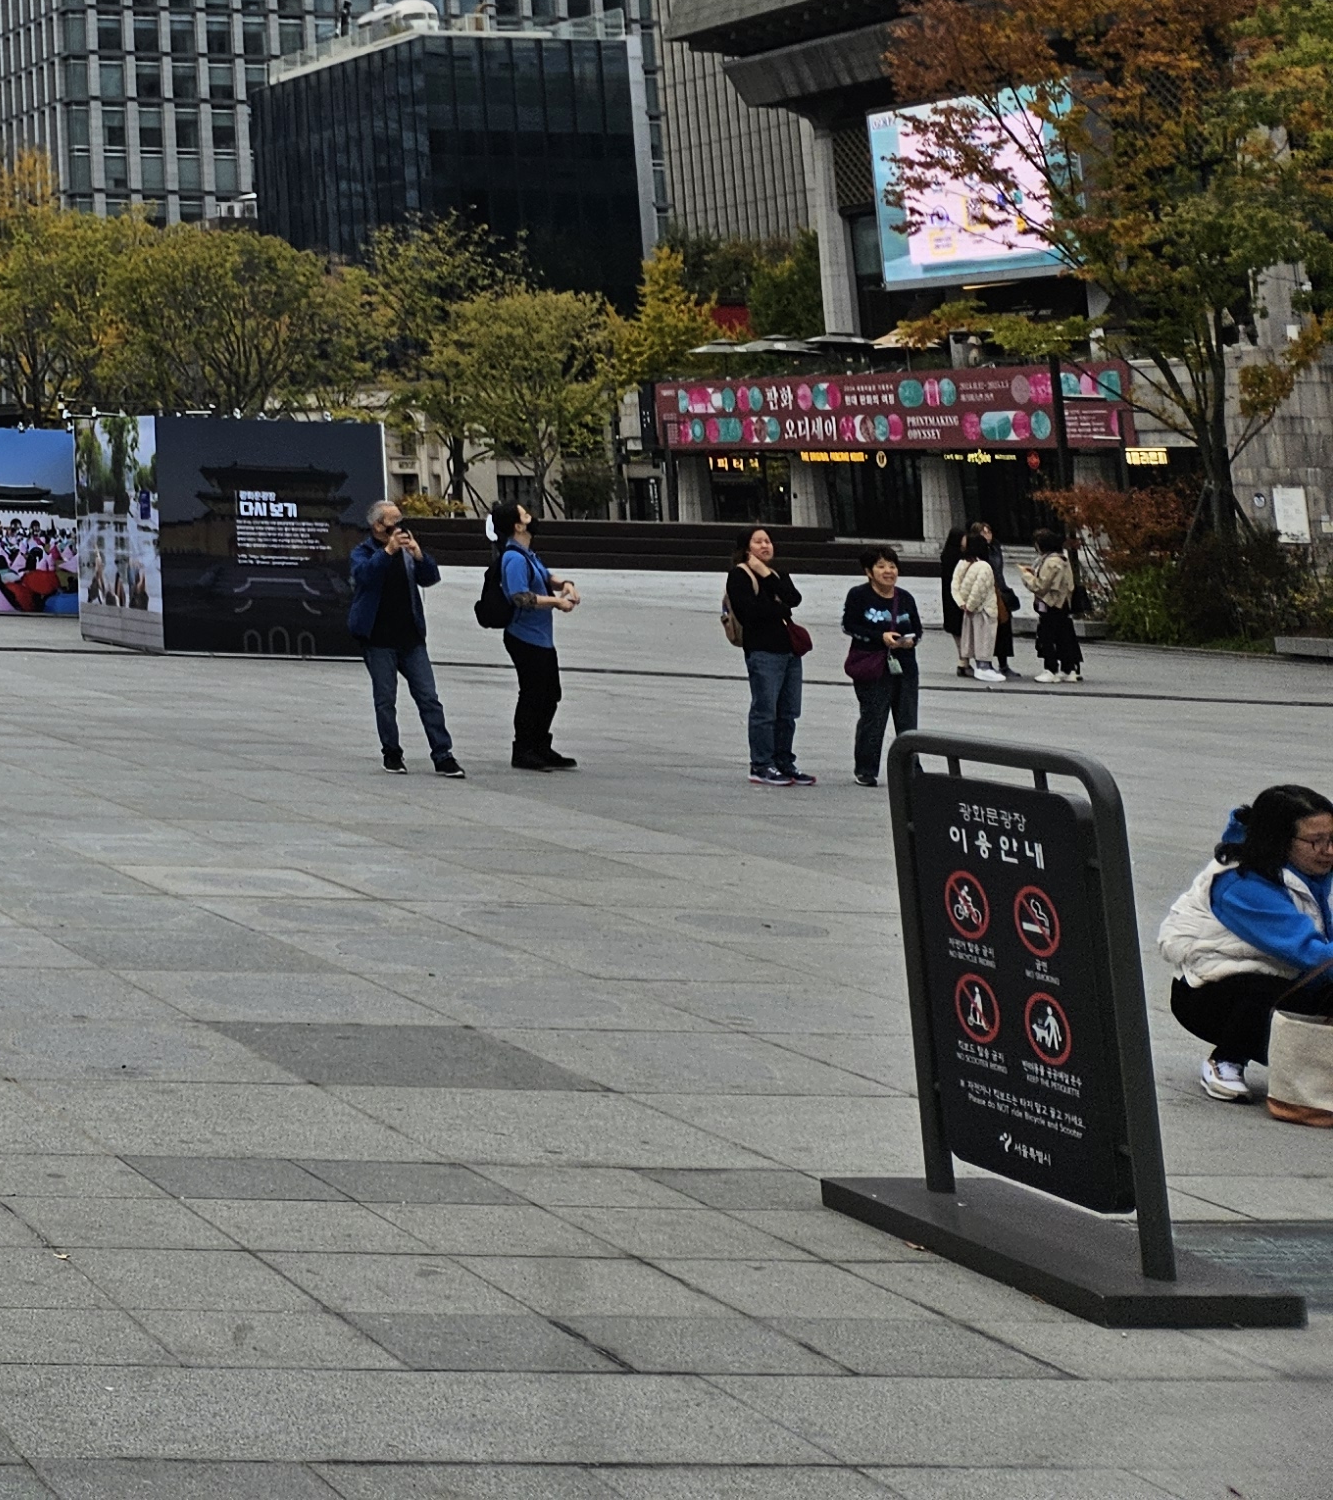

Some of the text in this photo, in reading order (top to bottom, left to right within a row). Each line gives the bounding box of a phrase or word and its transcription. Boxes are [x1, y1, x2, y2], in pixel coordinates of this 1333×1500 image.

[765, 385, 793, 411] 판화
[784, 415, 837, 442] 오디세이
[906, 415, 960, 427] PRINTMAKING
[907, 428, 941, 440] ODYSSEY
[239, 501, 298, 518] 다시 보기
[958, 802, 1027, 832] 광화문광장
[996, 1102, 1010, 1114] NOT
